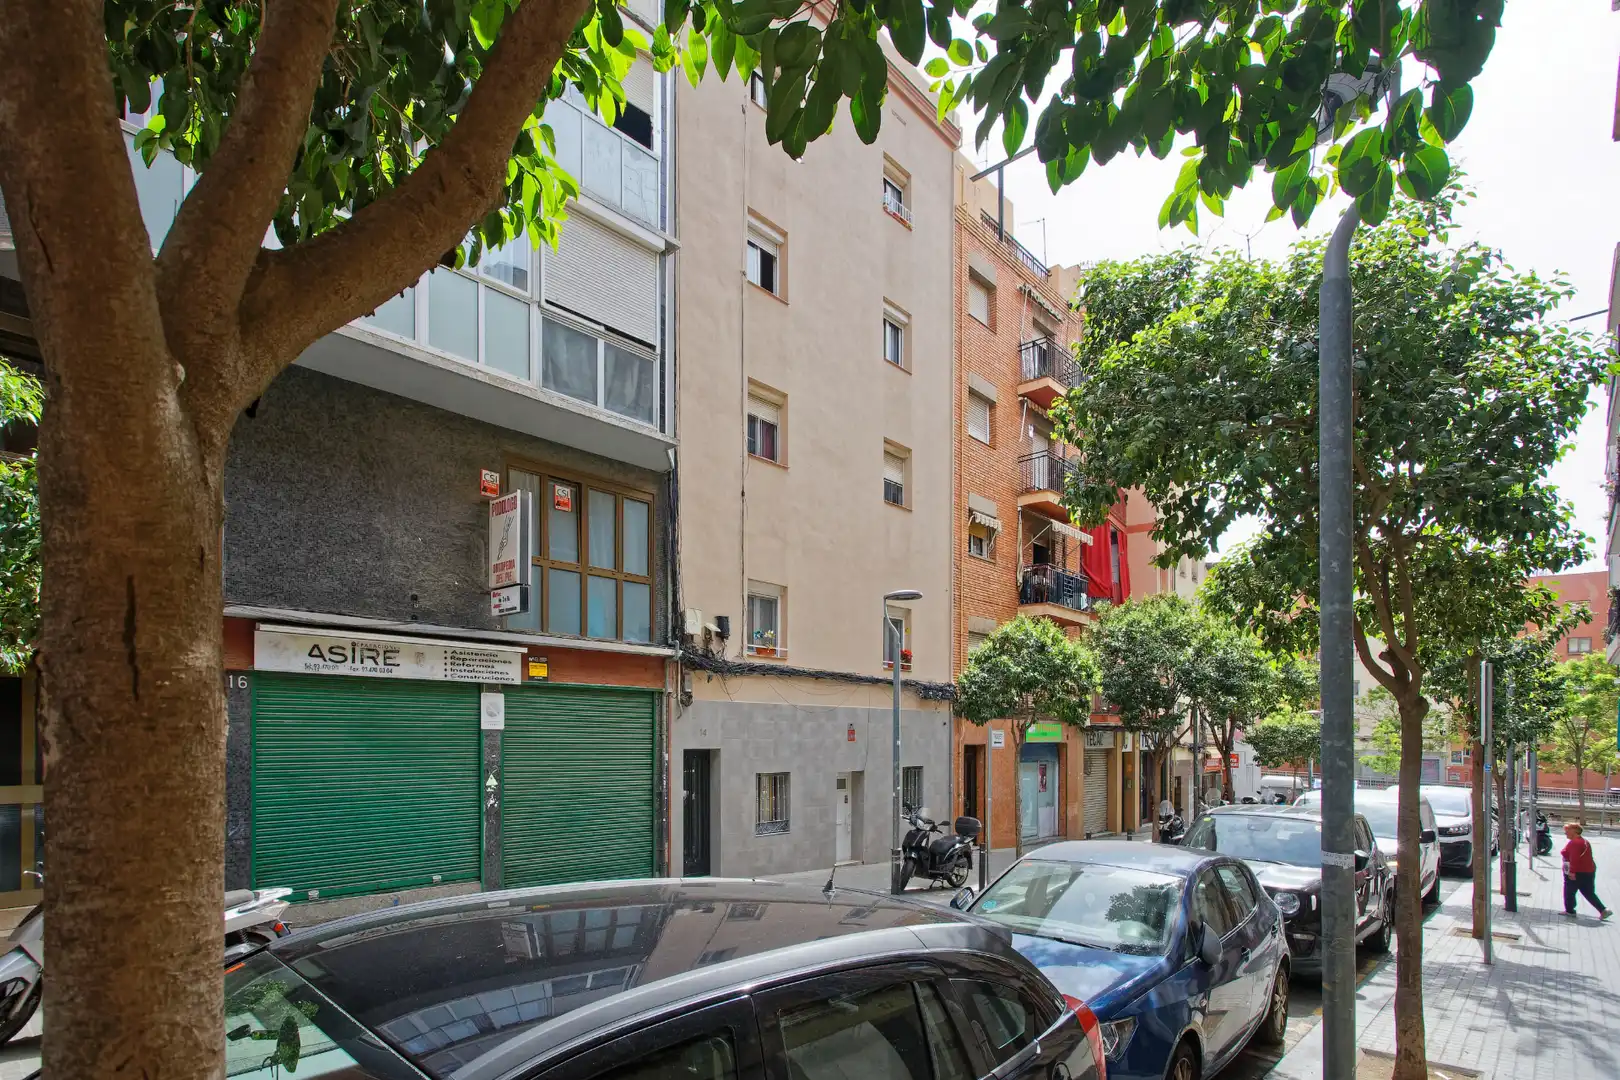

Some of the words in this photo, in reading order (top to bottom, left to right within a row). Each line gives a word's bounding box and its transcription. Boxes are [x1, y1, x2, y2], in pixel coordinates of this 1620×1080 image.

[483, 473, 498, 483] CSI
[450, 650, 499, 658] Asistencia
[450, 655, 513, 665] Reparaciones
[450, 661, 495, 669] Reformas
[450, 667, 510, 676] Instalaciones
[228, 675, 248, 689] 16
[450, 673, 515, 682] Construciones
